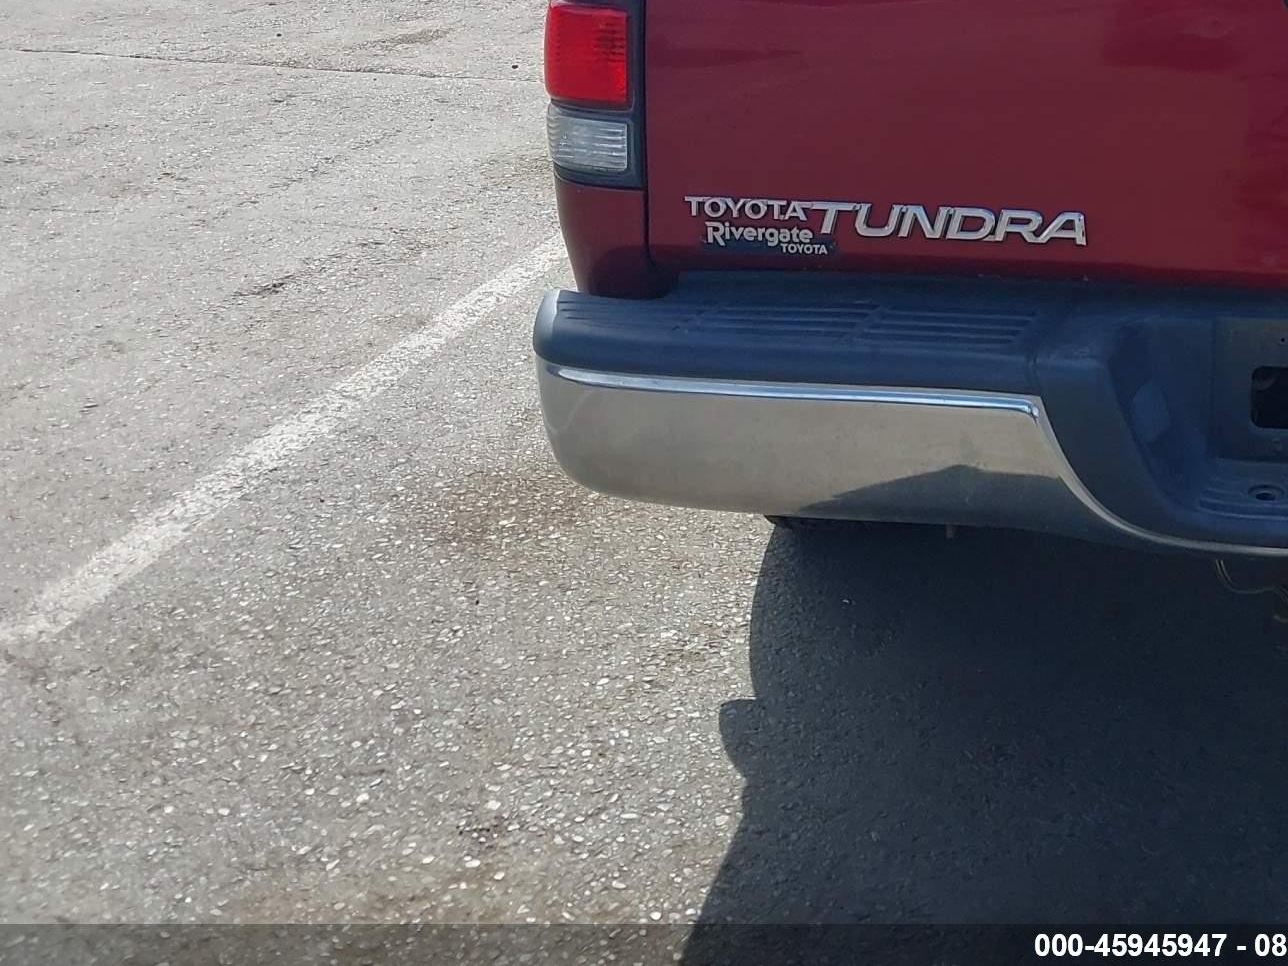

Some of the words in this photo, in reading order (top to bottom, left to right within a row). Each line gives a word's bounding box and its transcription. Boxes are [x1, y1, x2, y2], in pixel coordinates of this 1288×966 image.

[684, 196, 811, 221] TOYOTA
[811, 201, 1087, 245] TUNDRA
[705, 221, 813, 247] Rivergate
[780, 242, 828, 255] TOYOTA
